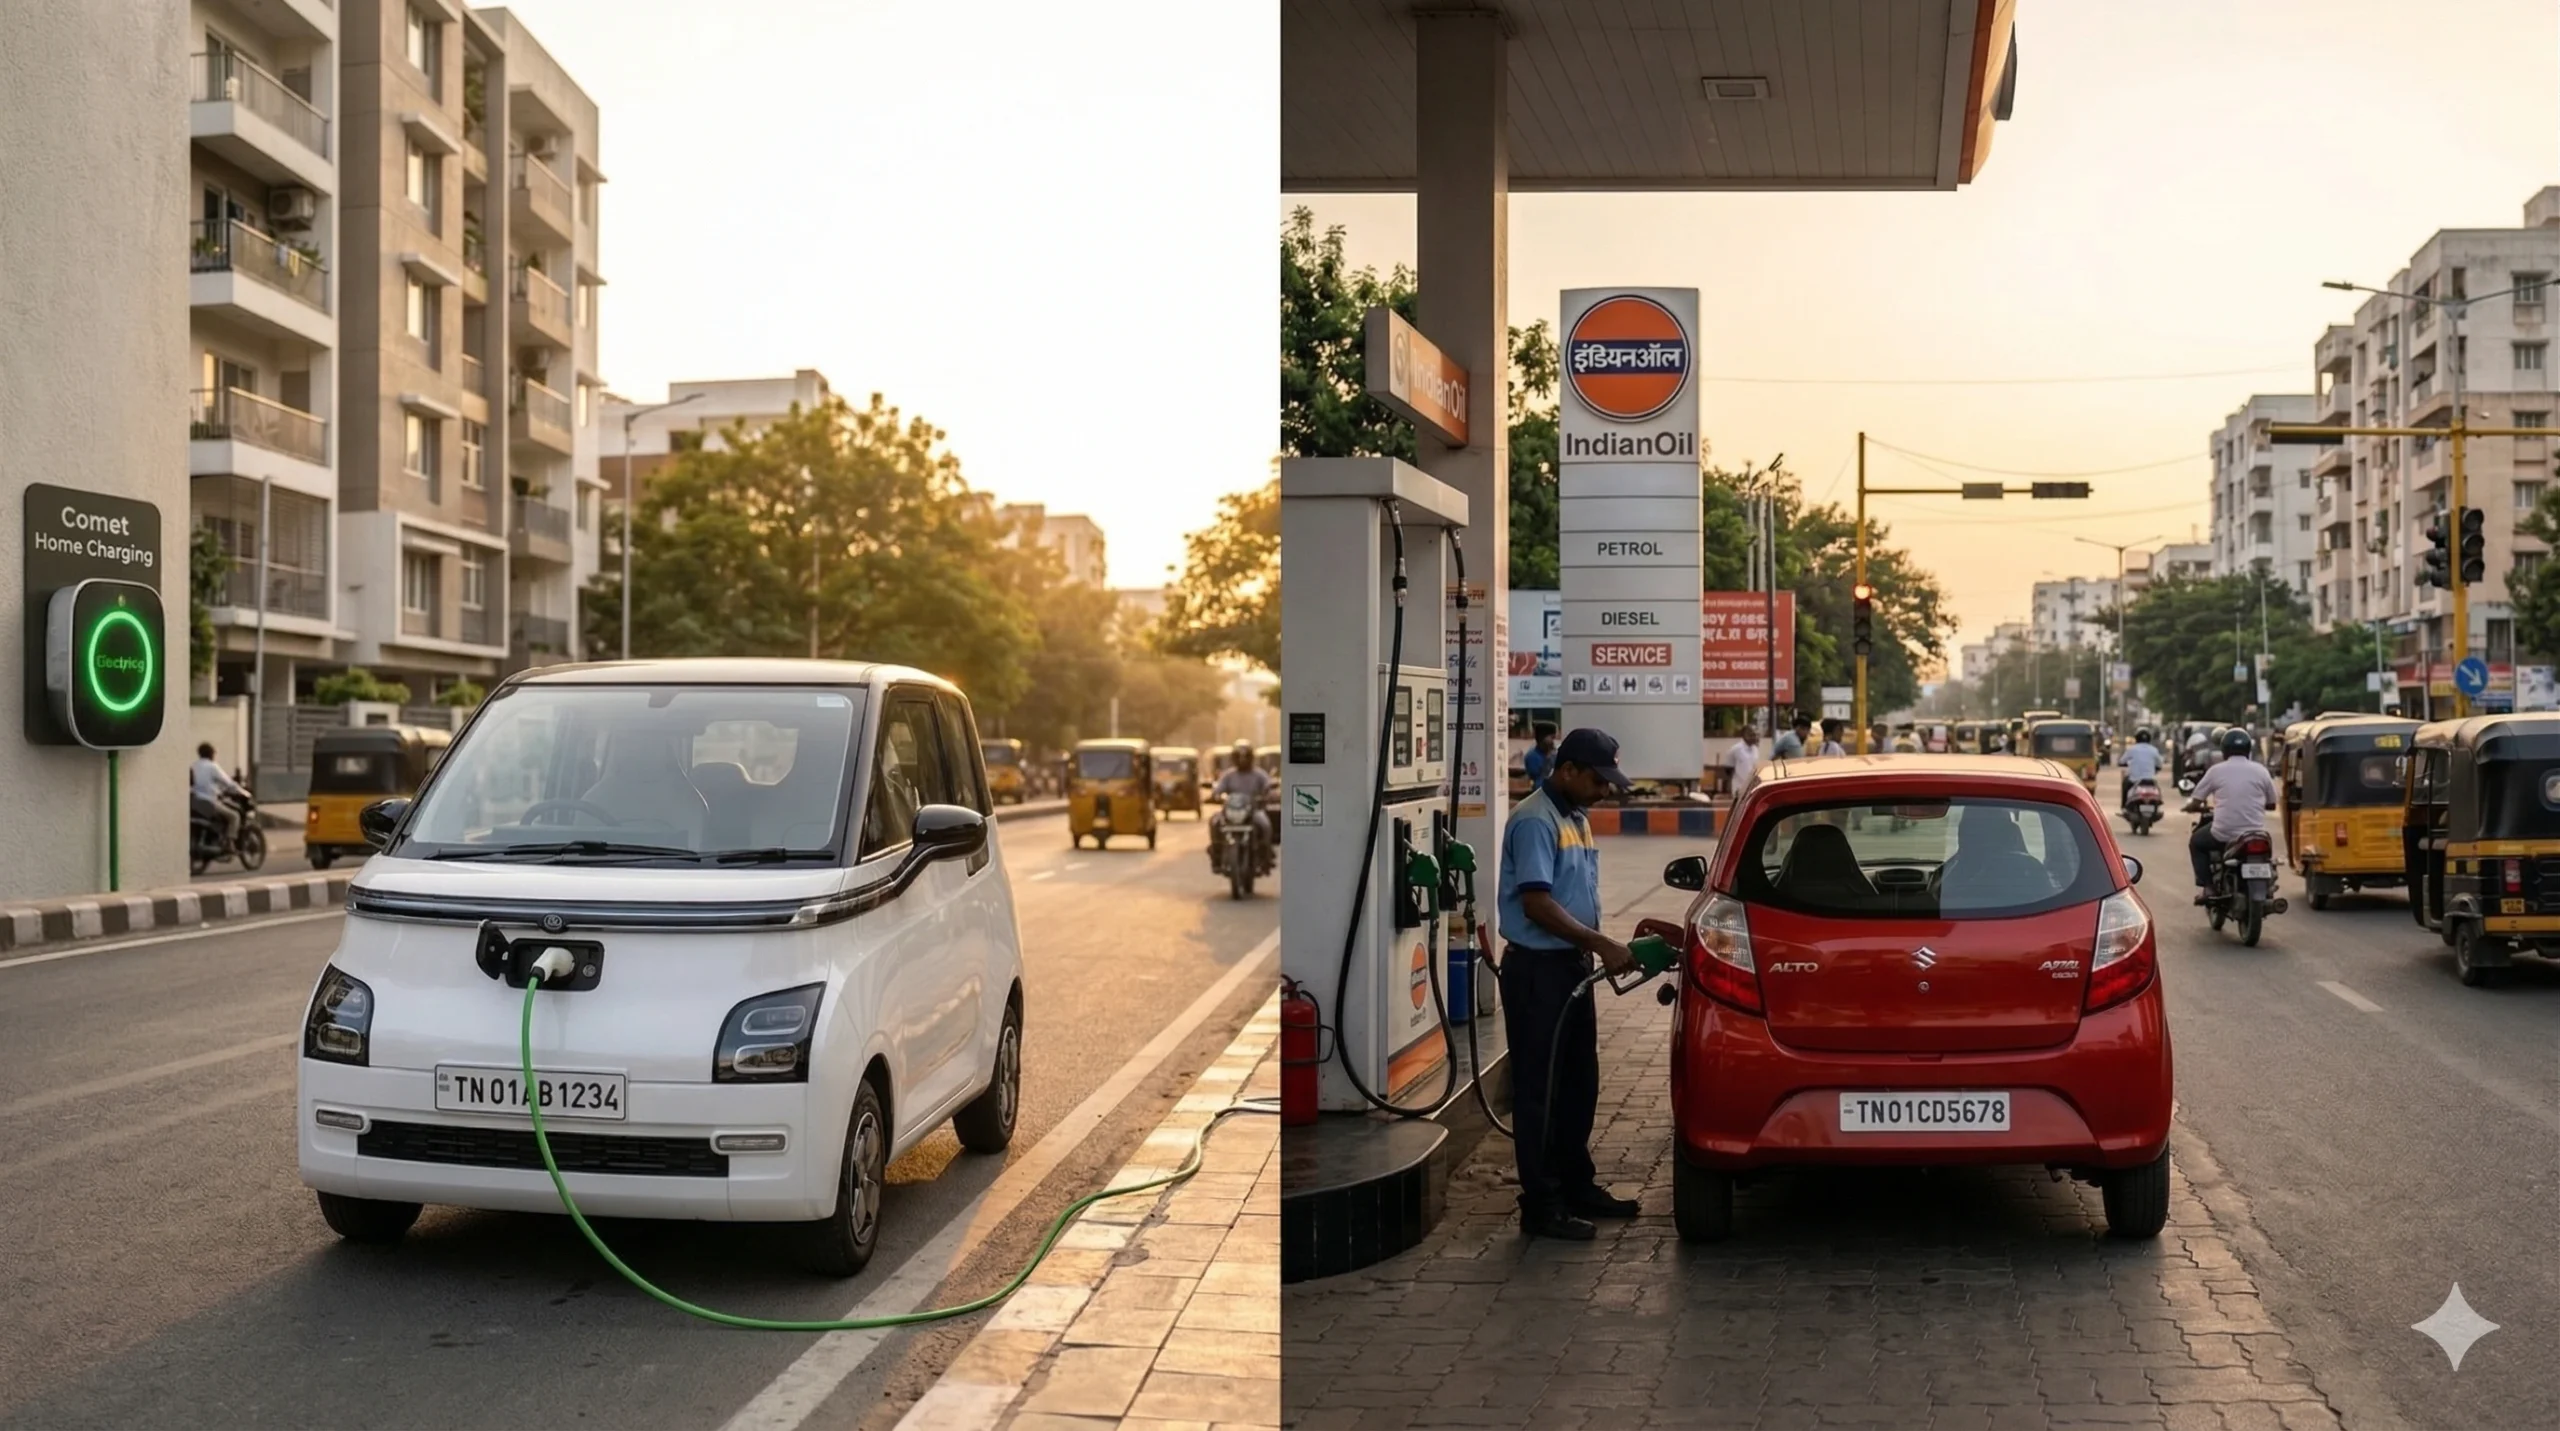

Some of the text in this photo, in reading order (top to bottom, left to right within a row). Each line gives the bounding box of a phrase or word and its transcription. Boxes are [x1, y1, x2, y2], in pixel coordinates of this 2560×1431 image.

[1574, 343, 1683, 373] इंडियनऑल
[1566, 431, 1693, 456] IndianOil
[61, 505, 130, 537] Comet
[35, 531, 154, 568] Home Charging
[1597, 541, 1664, 556] PETROL
[1601, 611, 1660, 626] DIESEL
[1595, 646, 1668, 664] SERVICE
[1768, 961, 1819, 973] ALTO
[1856, 1100, 2006, 1124] TN01CD5678
